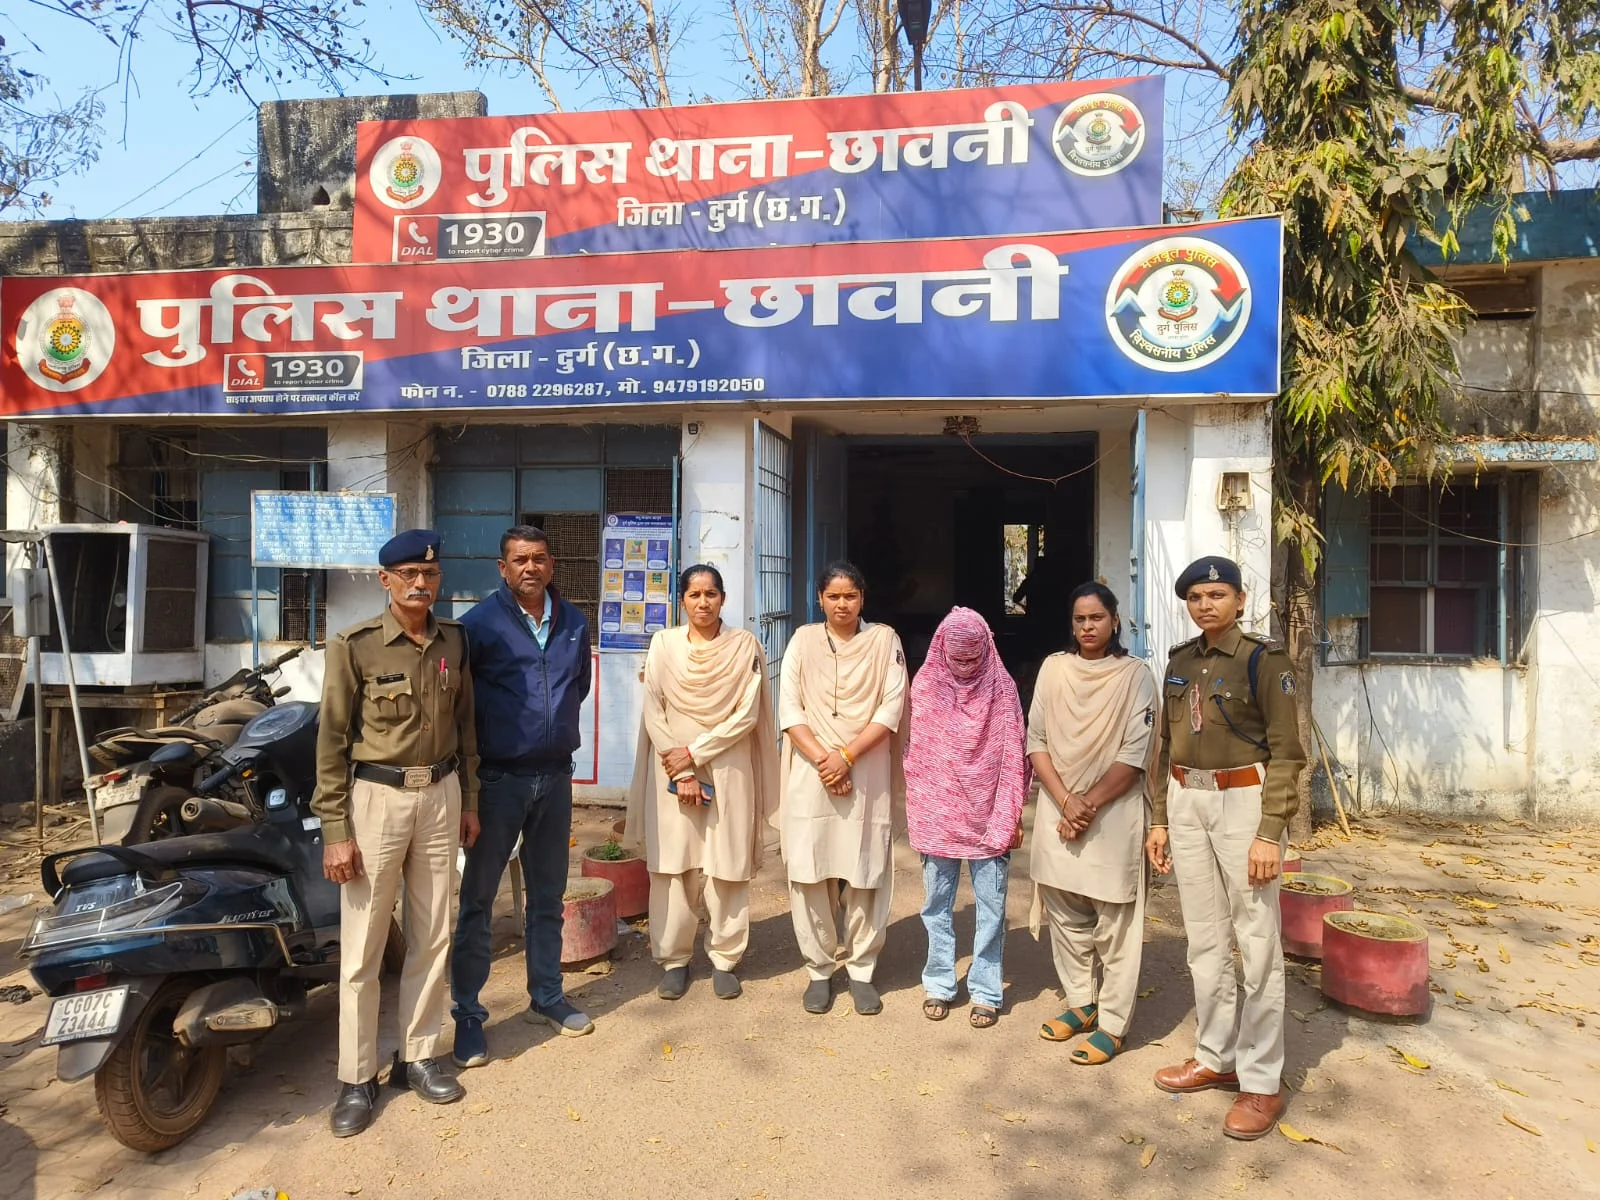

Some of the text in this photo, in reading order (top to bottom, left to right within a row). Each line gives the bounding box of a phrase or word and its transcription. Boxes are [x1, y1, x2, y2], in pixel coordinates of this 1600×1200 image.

[463, 127, 632, 207] पुलिस
[617, 196, 685, 228] जिला
[445, 222, 525, 246] 1930
[401, 246, 433, 256] DIAL
[1184, 248, 1219, 268] पुलिस
[136, 274, 403, 367] पुलिस
[1157, 320, 1198, 335] दुर्ग पुलिस
[1185, 334, 1217, 359] पुलिस
[272, 359, 344, 377] 1930
[461, 346, 532, 371] जिला
[231, 378, 260, 386] DIAL
[400, 383, 438, 399] फोन
[442, 386, 463, 399] न.
[486, 384, 527, 398] 0788
[532, 382, 612, 399] 2296287,
[617, 378, 646, 395] मो.
[653, 378, 765, 394] 9479192050
[75, 902, 97, 913] TVS
[64, 992, 113, 1015] CG07C
[57, 1011, 107, 1035] Z3444
